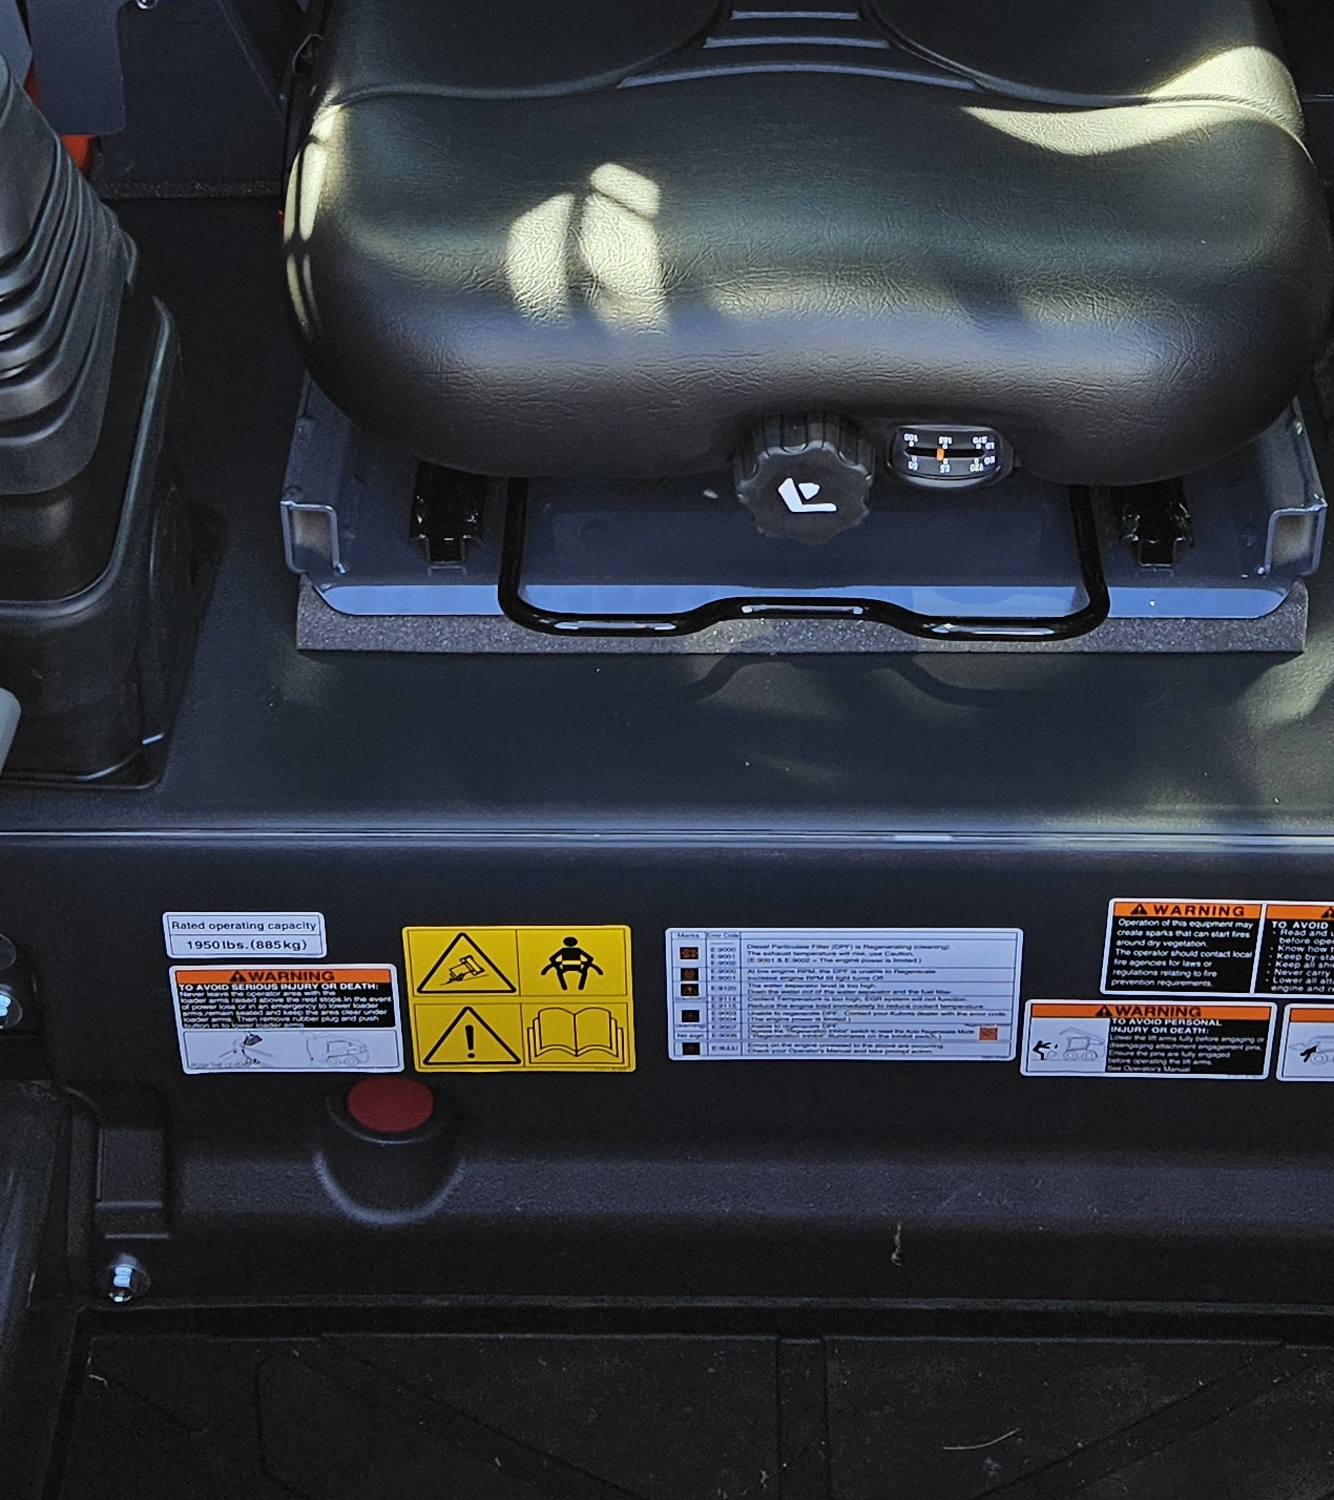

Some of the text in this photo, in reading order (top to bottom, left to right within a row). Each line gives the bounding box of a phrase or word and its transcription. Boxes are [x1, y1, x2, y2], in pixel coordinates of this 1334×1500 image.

[1154, 905, 1245, 916] WARNING
[172, 921, 316, 931] Rated operating capacity
[1118, 918, 1159, 927] Operation
[1272, 921, 1287, 929] TO
[1293, 921, 1328, 929] AVOID
[1280, 929, 1306, 937] Read
[1147, 940, 1161, 948] dry
[1277, 953, 1302, 961] Keep
[1275, 961, 1300, 969] Keep
[248, 971, 335, 982] WARNING
[1306, 970, 1330, 979] carry
[1271, 985, 1303, 993] engine
[1115, 1007, 1202, 1017] WARNING
